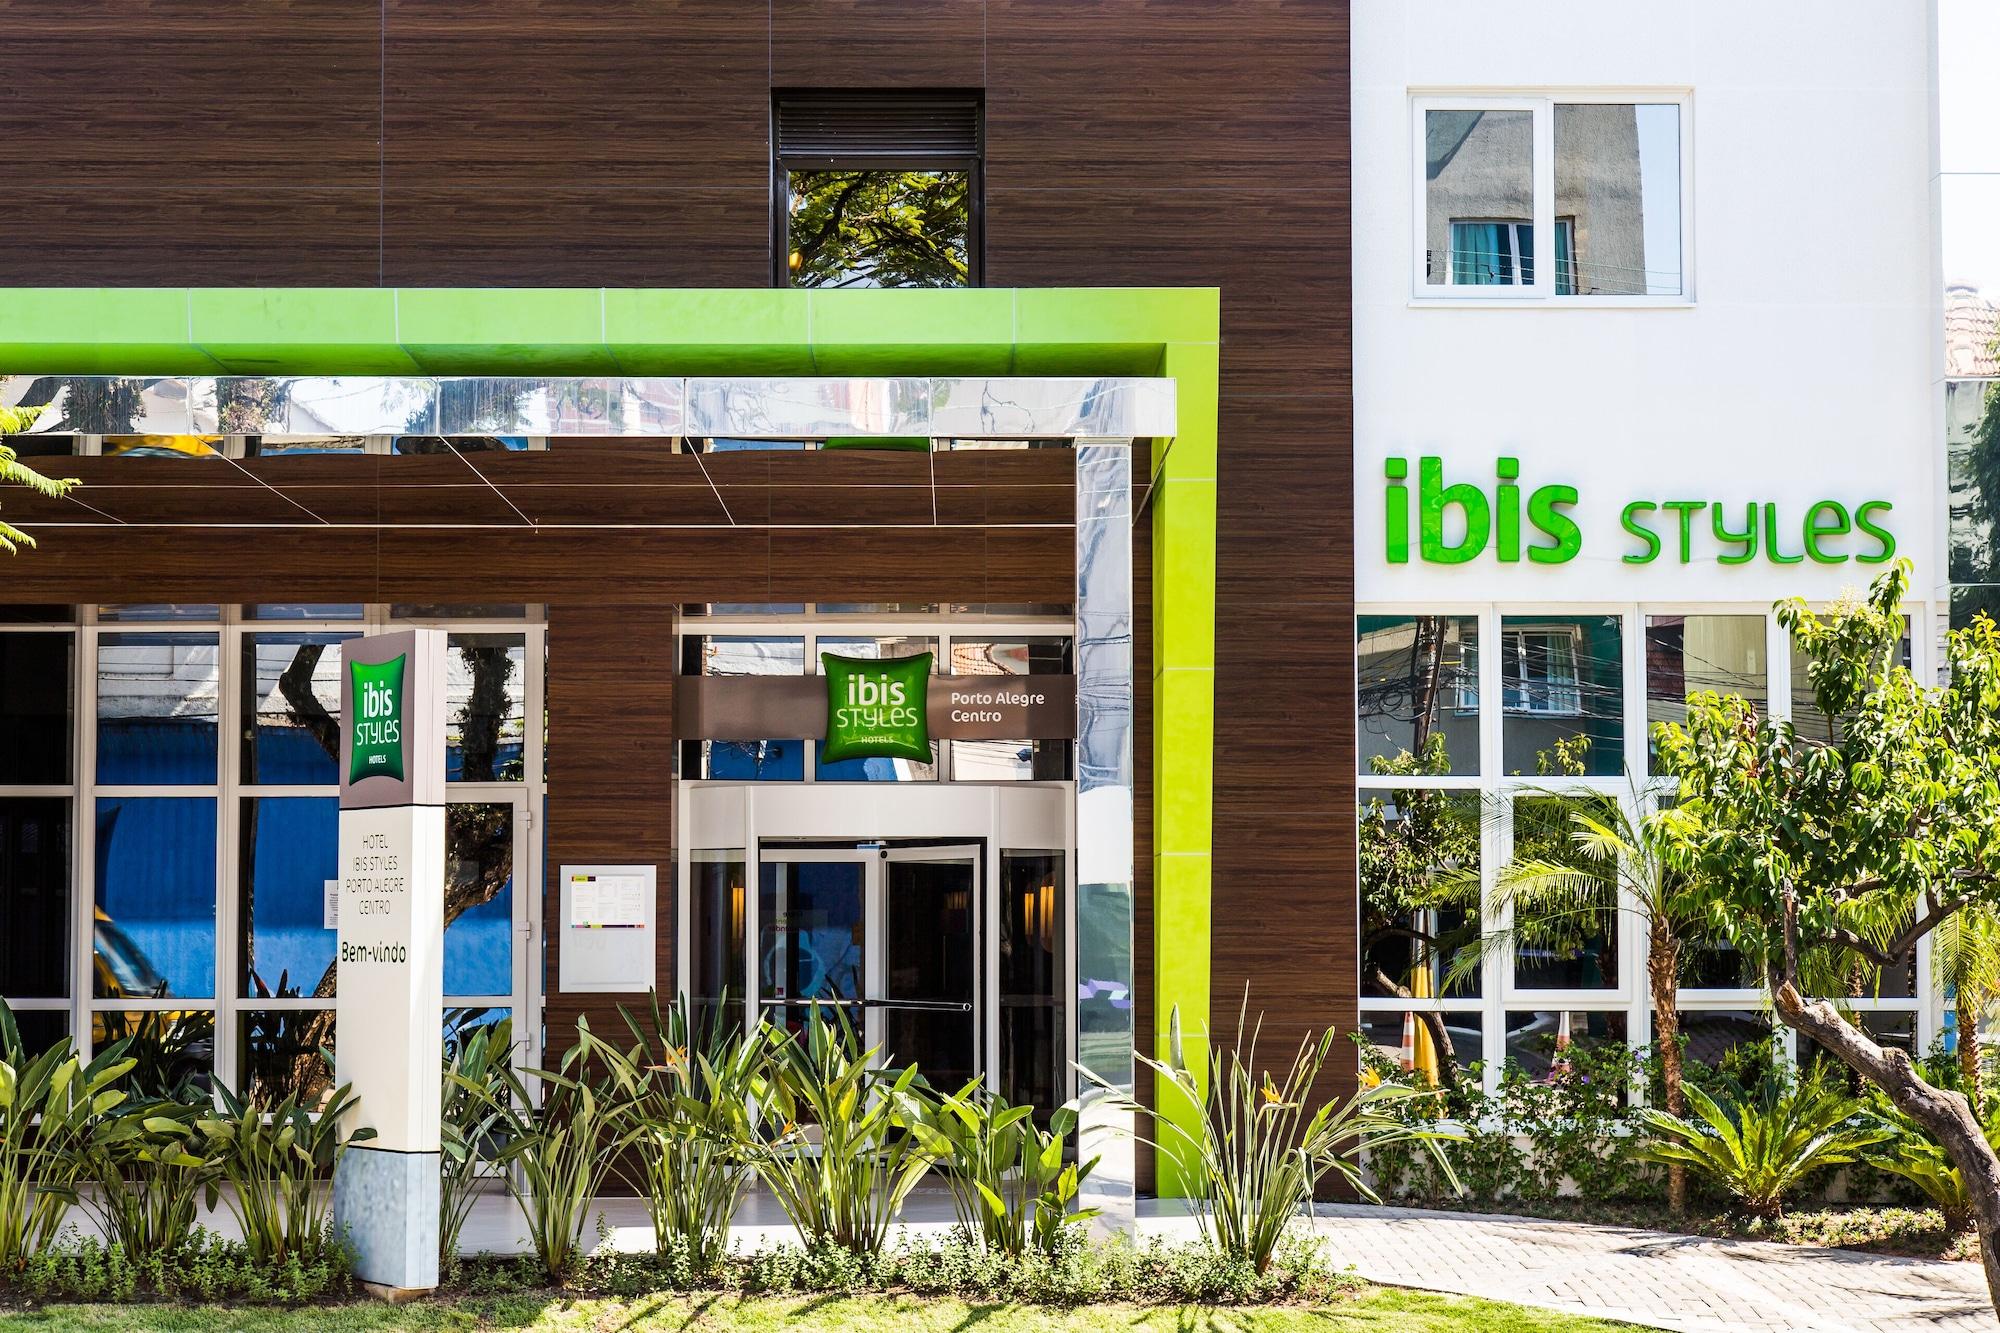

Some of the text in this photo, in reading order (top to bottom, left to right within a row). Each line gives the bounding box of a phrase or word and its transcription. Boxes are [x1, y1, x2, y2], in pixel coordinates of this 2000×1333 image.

[1385, 456, 1582, 565] ibis
[848, 673, 906, 706] ibis
[363, 680, 393, 719] ibis
[951, 691, 1045, 708] Porto Alegre
[951, 709, 1002, 723] Centro
[861, 735, 895, 744] HOTELS
[368, 754, 387, 765] HOTELS
[363, 834, 389, 849] HOTEL
[352, 855, 398, 871] IBIS STYLES
[346, 877, 405, 894] PORTO ALEGRE
[359, 899, 391, 915] CENTRO
[341, 940, 407, 964] Bem-vindo
